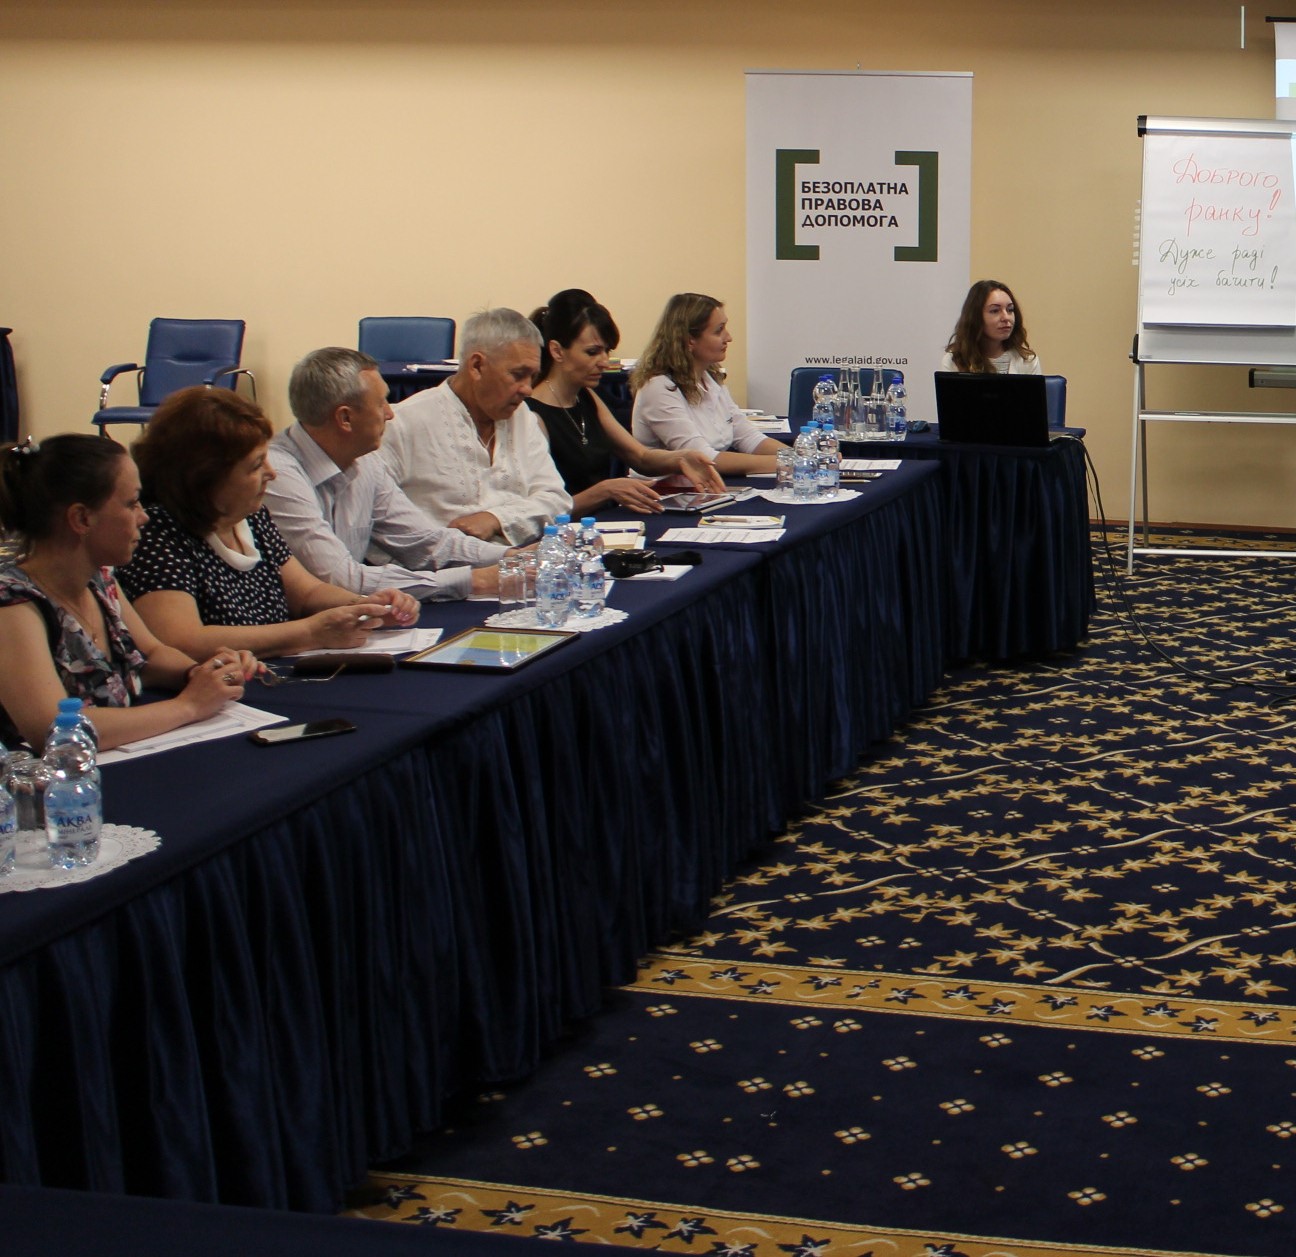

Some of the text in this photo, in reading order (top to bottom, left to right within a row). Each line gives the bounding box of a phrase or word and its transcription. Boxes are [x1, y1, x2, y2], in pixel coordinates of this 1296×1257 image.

[801, 181, 909, 195] БЕЗОПЛАТНА
[801, 198, 884, 211] ПРАВОВА
[801, 214, 899, 228] ДОПОМОГА
[805, 355, 908, 366] www.legalaid.gov.ua
[57, 814, 92, 827] АКВА
